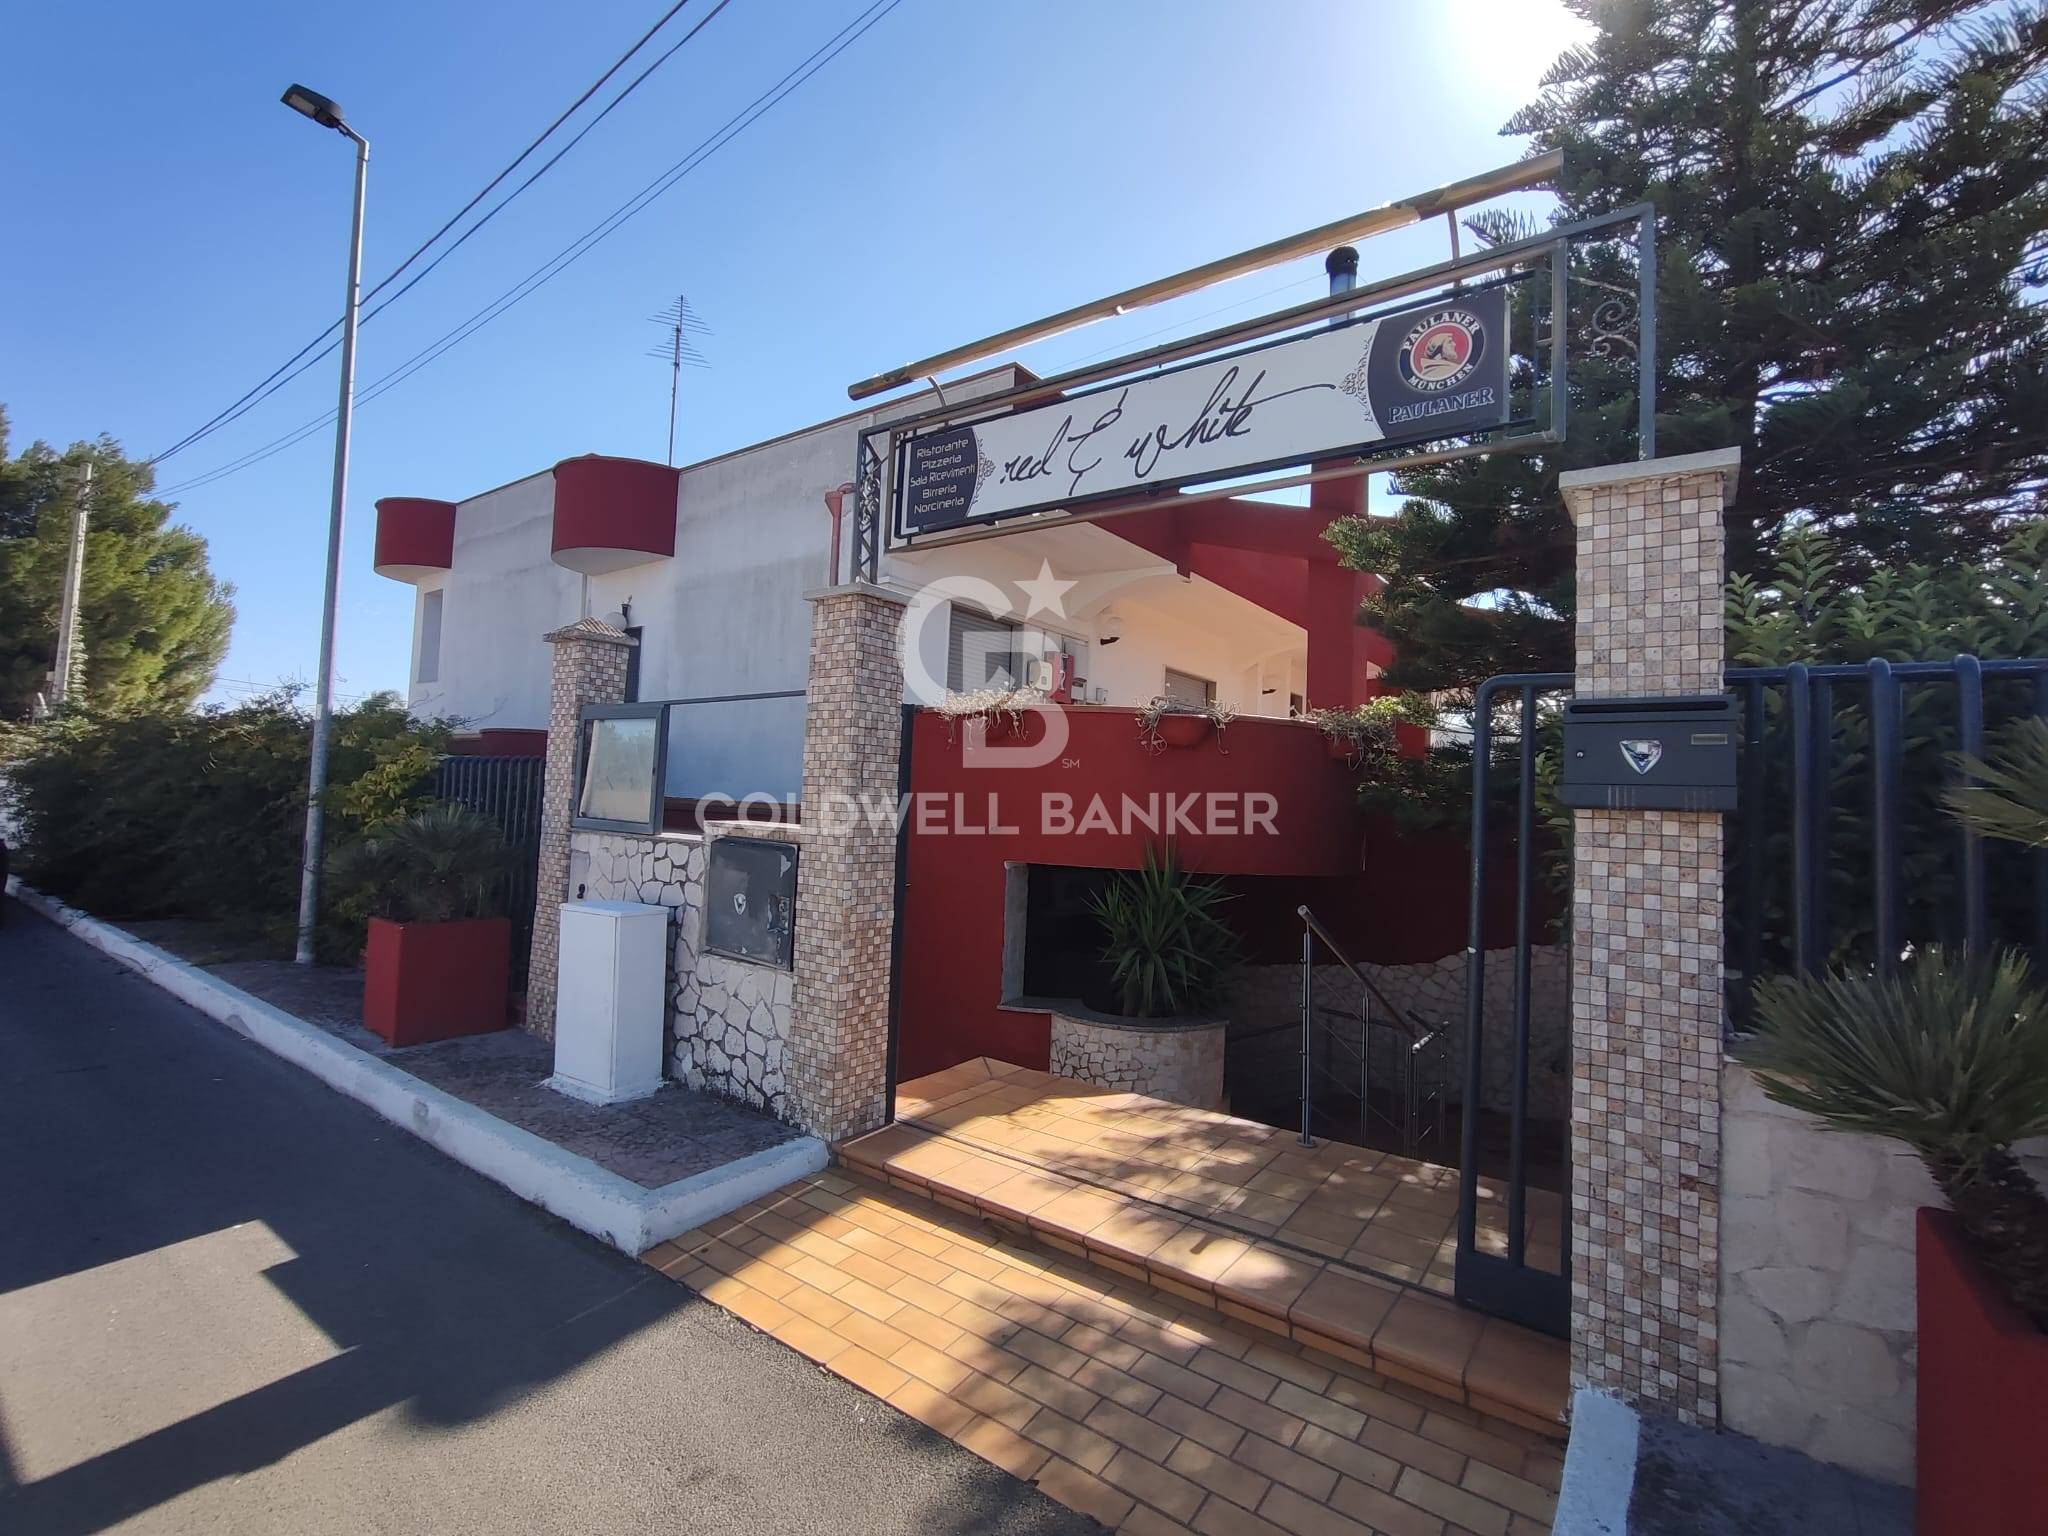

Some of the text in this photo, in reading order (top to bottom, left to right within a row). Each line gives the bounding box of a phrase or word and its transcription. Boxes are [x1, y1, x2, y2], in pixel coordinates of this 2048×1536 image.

[1402, 312, 1480, 350] PAULANER
[1387, 387, 1495, 424] PAULANER
[1000, 415, 1072, 485] red
[1124, 366, 1336, 478] white
[916, 439, 969, 458] Ristorante
[921, 454, 962, 471] Pizzeria
[910, 463, 976, 487] Sala Ricevimenti
[922, 484, 957, 499] Birreria
[914, 496, 965, 514] Norcineria
